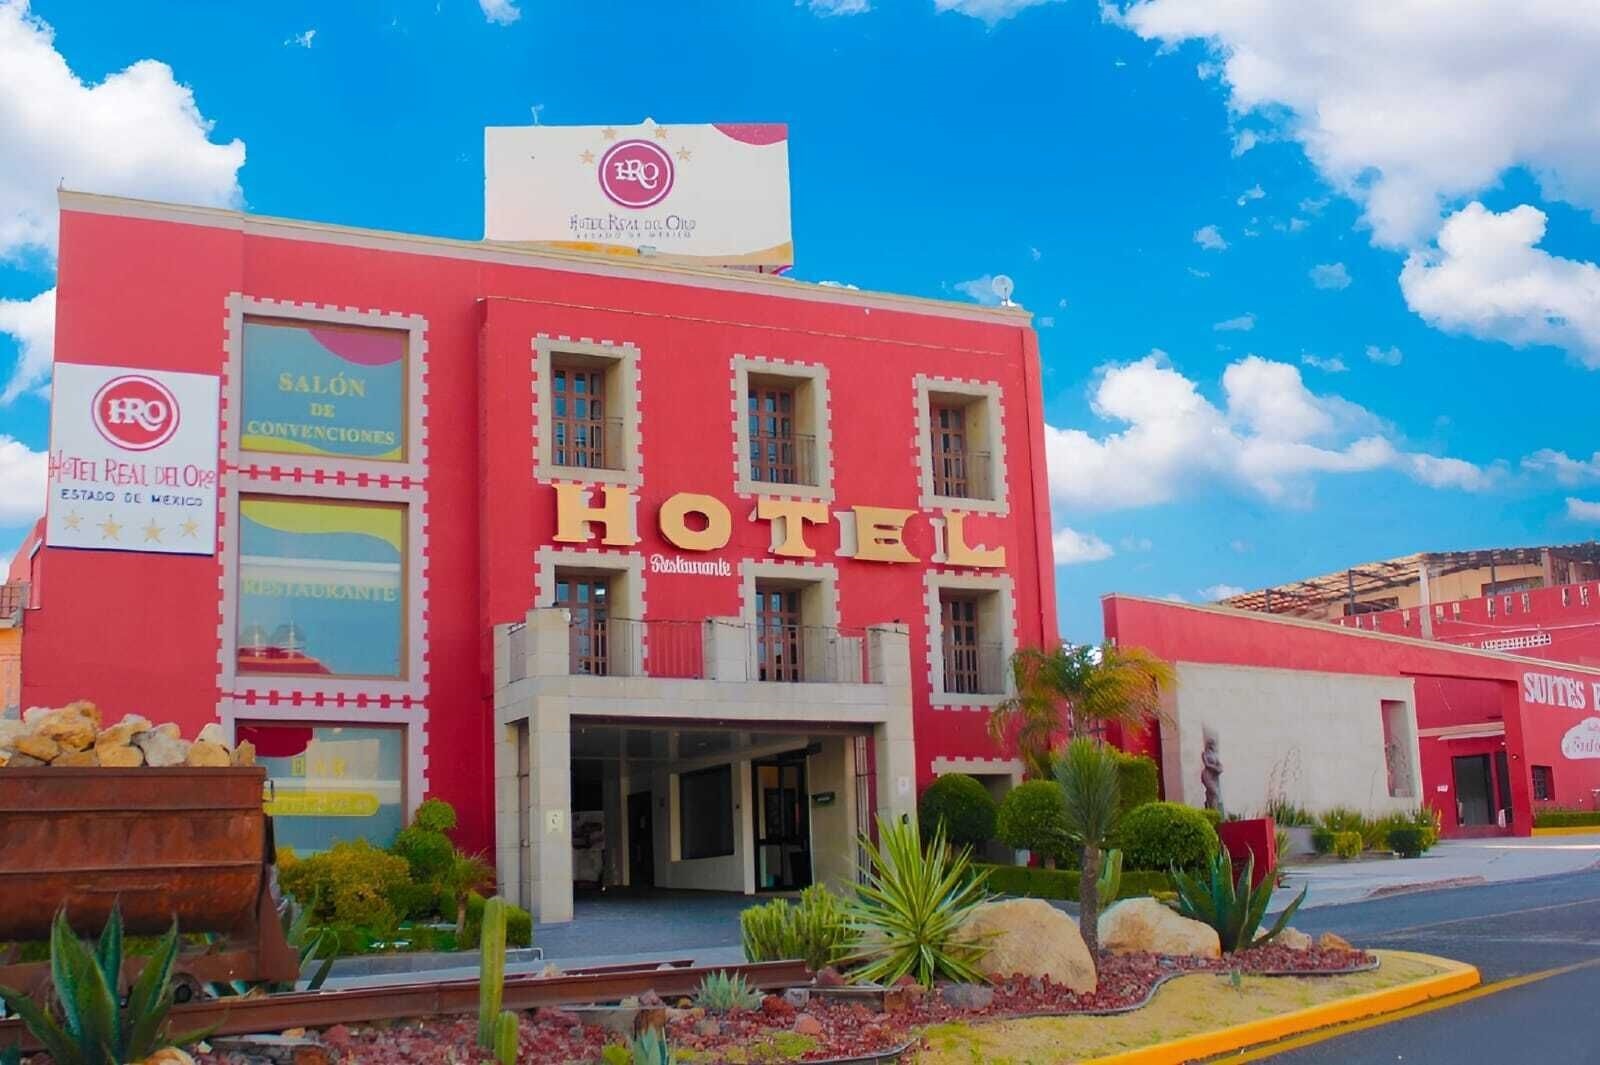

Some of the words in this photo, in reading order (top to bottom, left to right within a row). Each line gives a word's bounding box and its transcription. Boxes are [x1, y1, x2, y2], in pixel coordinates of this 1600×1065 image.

[278, 372, 367, 397] SALÓN
[309, 402, 336, 418] DE
[247, 420, 395, 445] CONVENCIONES
[104, 458, 149, 487] REAL
[154, 465, 181, 488] DEL
[60, 488, 116, 503] ESTADO
[124, 492, 142, 504] DE
[552, 481, 1006, 569] HOTEL
[650, 553, 732, 577] Restaurante
[241, 577, 397, 602] RESTAURANTE
[1523, 671, 1586, 710] SUITES
